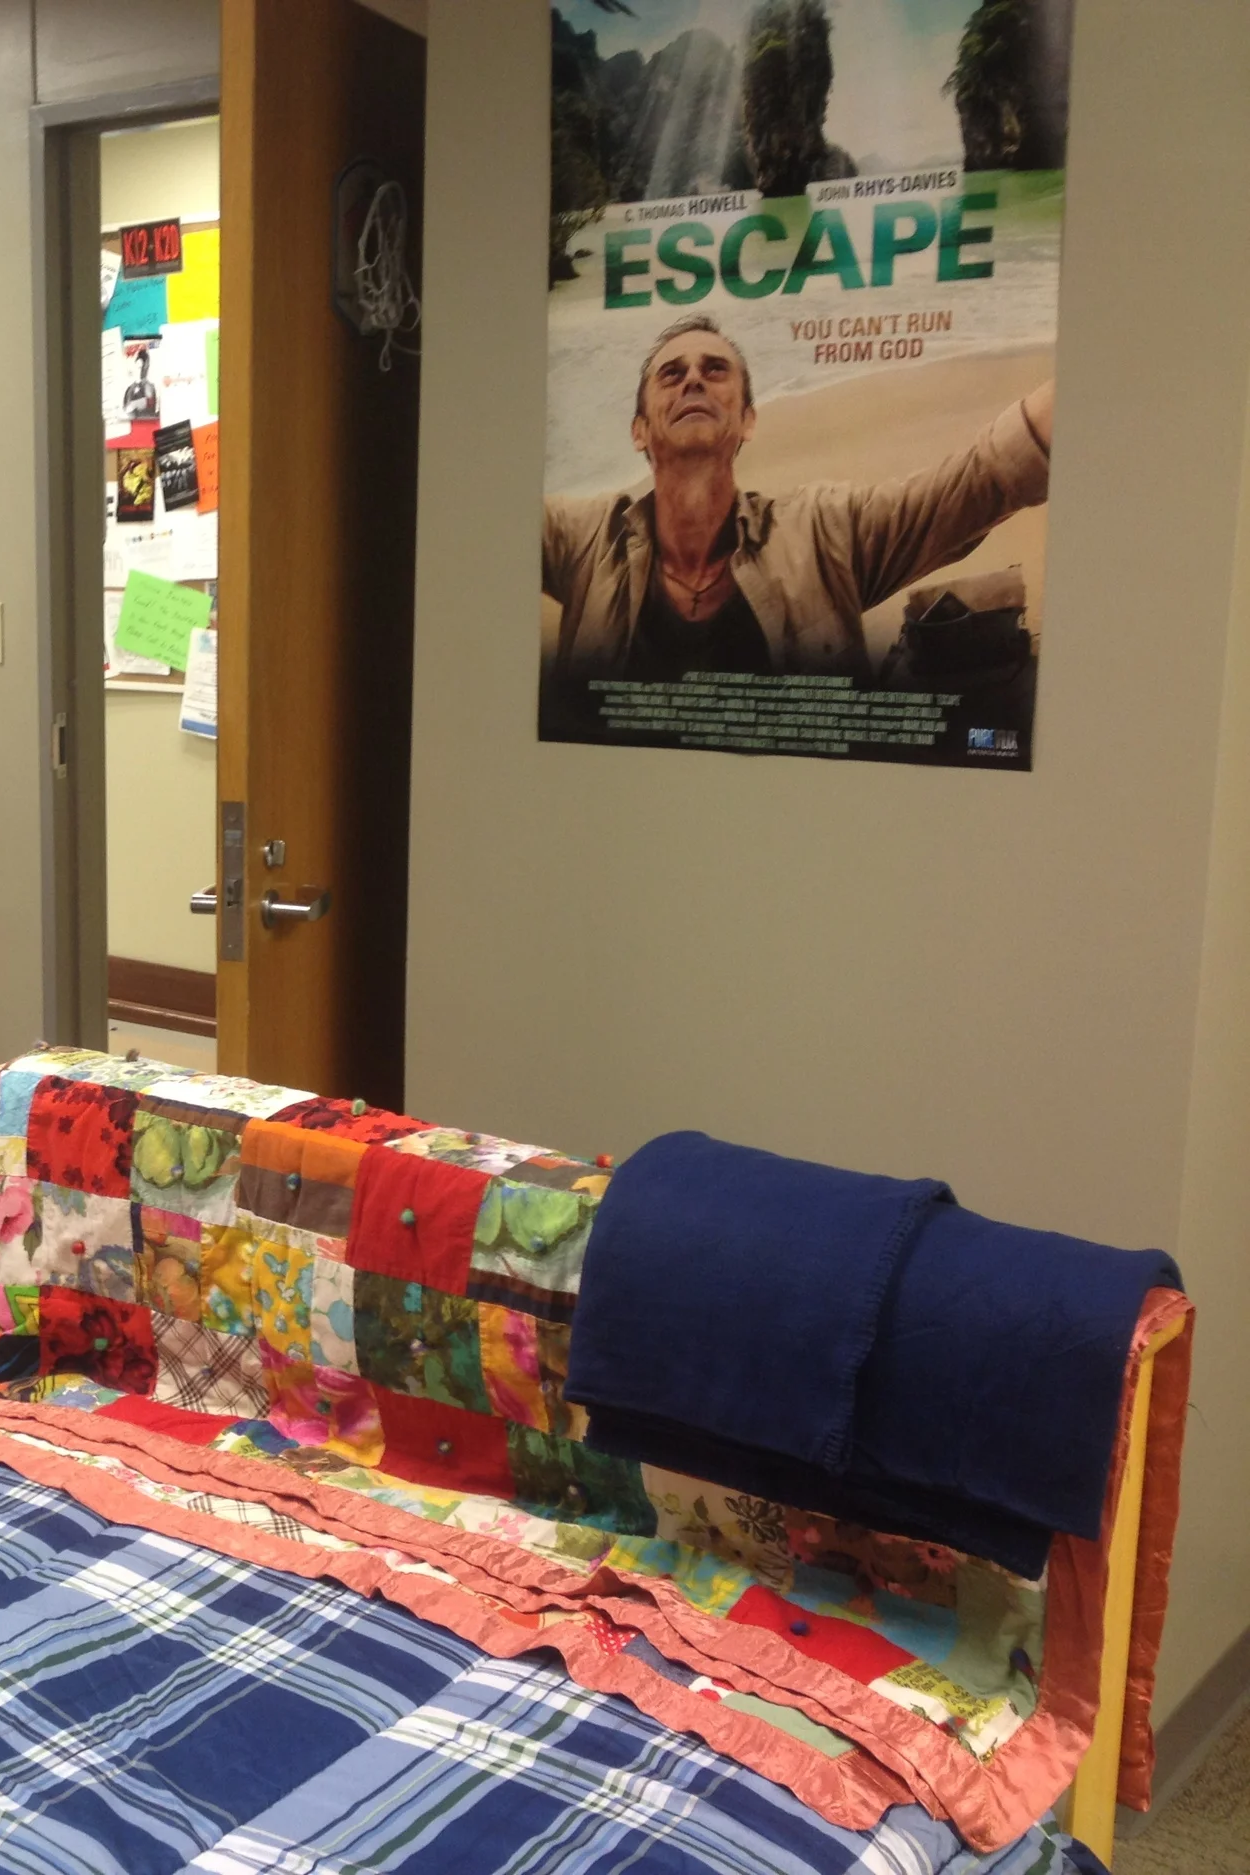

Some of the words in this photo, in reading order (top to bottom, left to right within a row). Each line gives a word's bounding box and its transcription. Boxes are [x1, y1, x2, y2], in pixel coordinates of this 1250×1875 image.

[817, 187, 850, 203] JOHN
[854, 171, 958, 198] RHYS-DAVIES
[638, 203, 685, 221] THOMAS
[688, 194, 748, 216] HOWELL
[603, 191, 998, 310] ESCAPE
[790, 318, 833, 342] YOU
[838, 313, 902, 338] CAN'T
[906, 310, 953, 334] RUN
[813, 341, 874, 365] FROM
[879, 337, 924, 361] GOD
